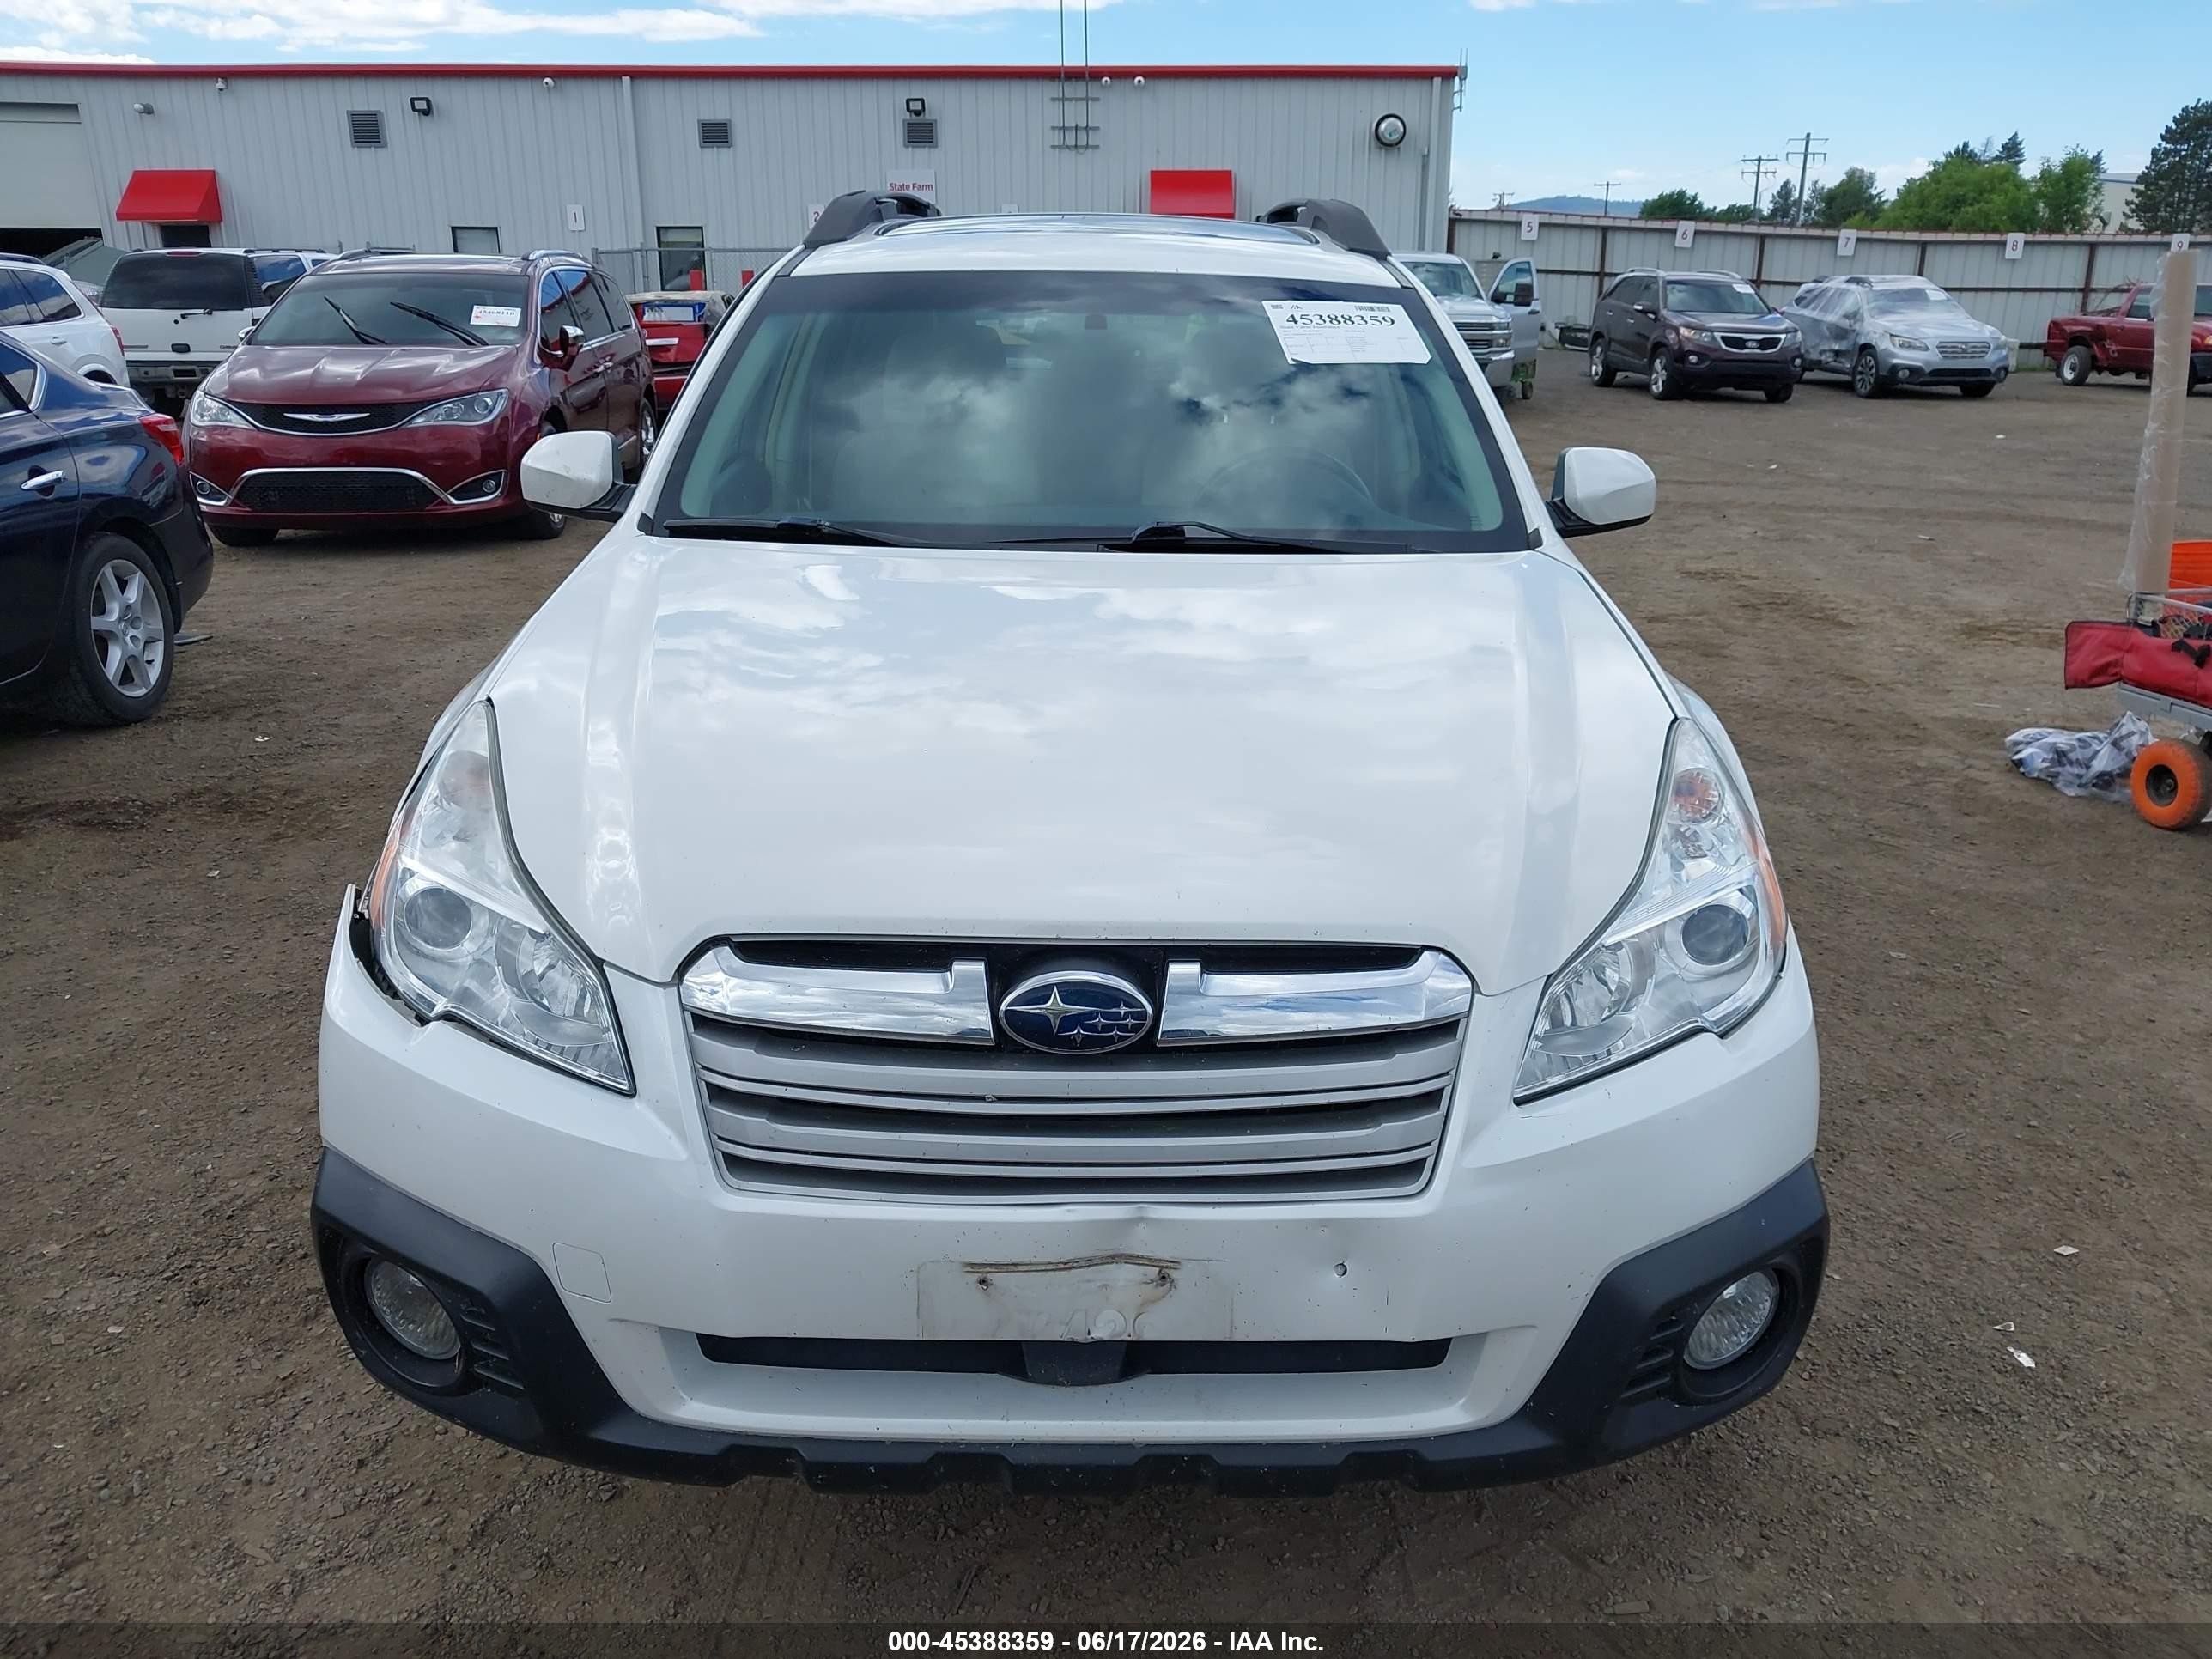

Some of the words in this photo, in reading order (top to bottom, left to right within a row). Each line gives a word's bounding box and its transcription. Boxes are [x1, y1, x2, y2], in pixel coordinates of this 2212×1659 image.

[889, 182, 910, 191] State
[912, 182, 933, 191] Farm
[1527, 221, 1534, 234] 5
[1681, 228, 1688, 240] 6
[1844, 236, 1851, 248] 7
[2012, 240, 2019, 252] 8
[1286, 313, 1395, 326] 45388359
